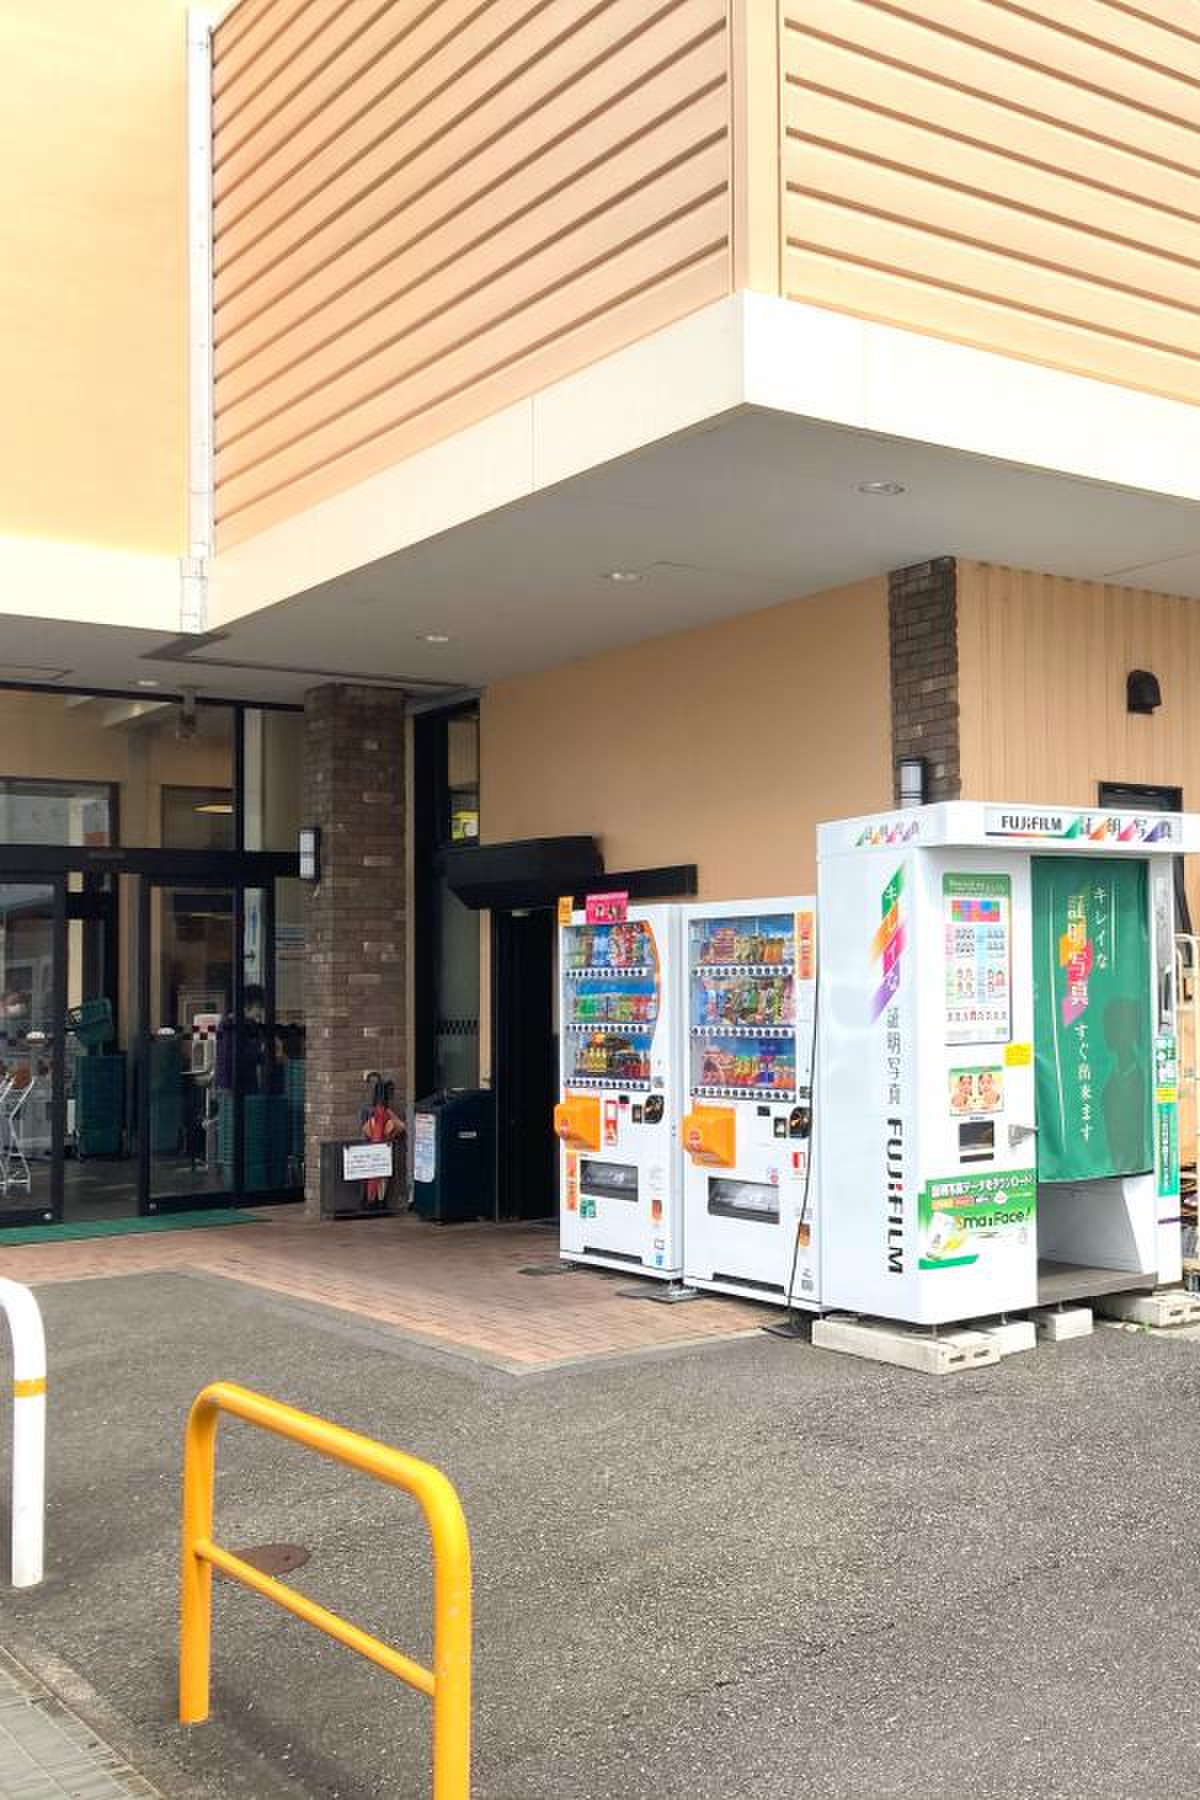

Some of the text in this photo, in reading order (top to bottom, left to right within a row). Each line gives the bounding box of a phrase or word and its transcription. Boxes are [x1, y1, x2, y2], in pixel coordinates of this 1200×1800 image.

[1001, 815, 1063, 831] FUJIFILM
[1067, 894, 1089, 1009] 証明写真
[1093, 886, 1107, 970] キレイな
[887, 1117, 904, 1274] FUJIFILM
